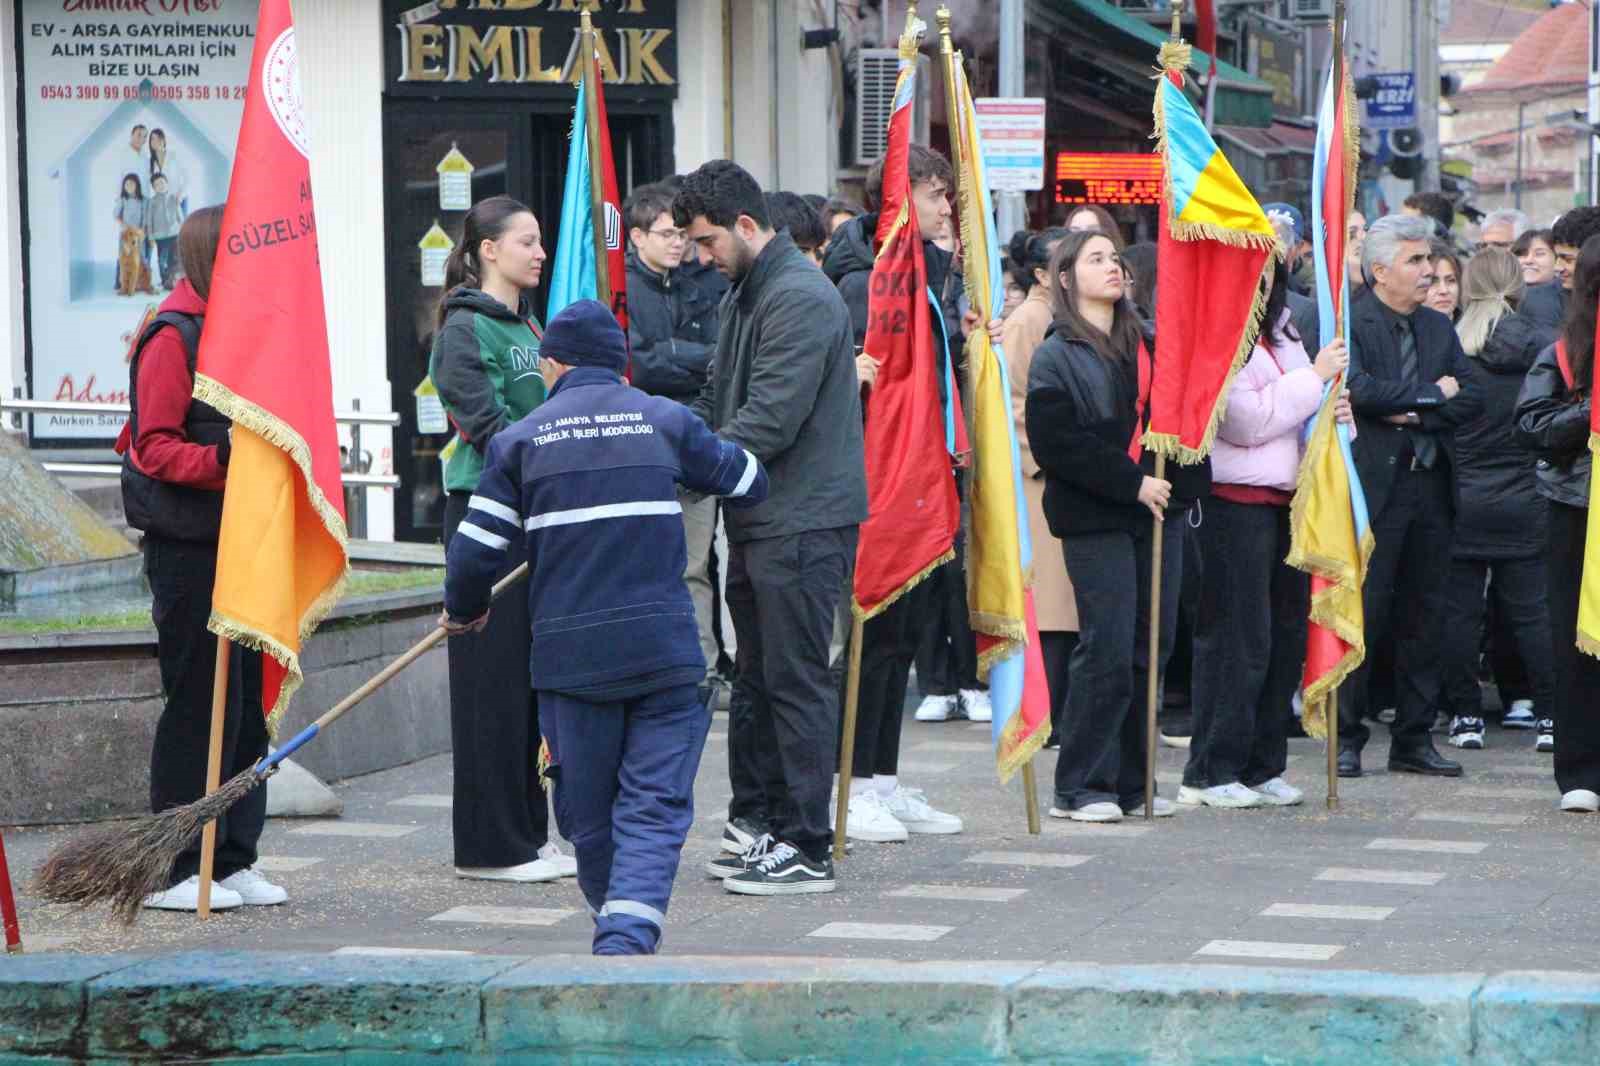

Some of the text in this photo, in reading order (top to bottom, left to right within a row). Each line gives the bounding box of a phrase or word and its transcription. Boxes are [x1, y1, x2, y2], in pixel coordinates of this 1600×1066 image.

[31, 24, 55, 37] EV
[72, 24, 121, 37] ARSA
[126, 20, 255, 38] GAYRİMENKUL
[51, 41, 236, 59] ALIM SATIMLARI İÇİN
[398, 24, 676, 84] EMLAK
[89, 61, 200, 79] BİZE ULAŞIN
[41, 86, 72, 99] 0543
[227, 217, 298, 255] GÜZEL
[555, 415, 591, 427] AMASYA
[594, 412, 643, 423] BELEDİYESİ
[533, 430, 570, 446] TEMİZLİK
